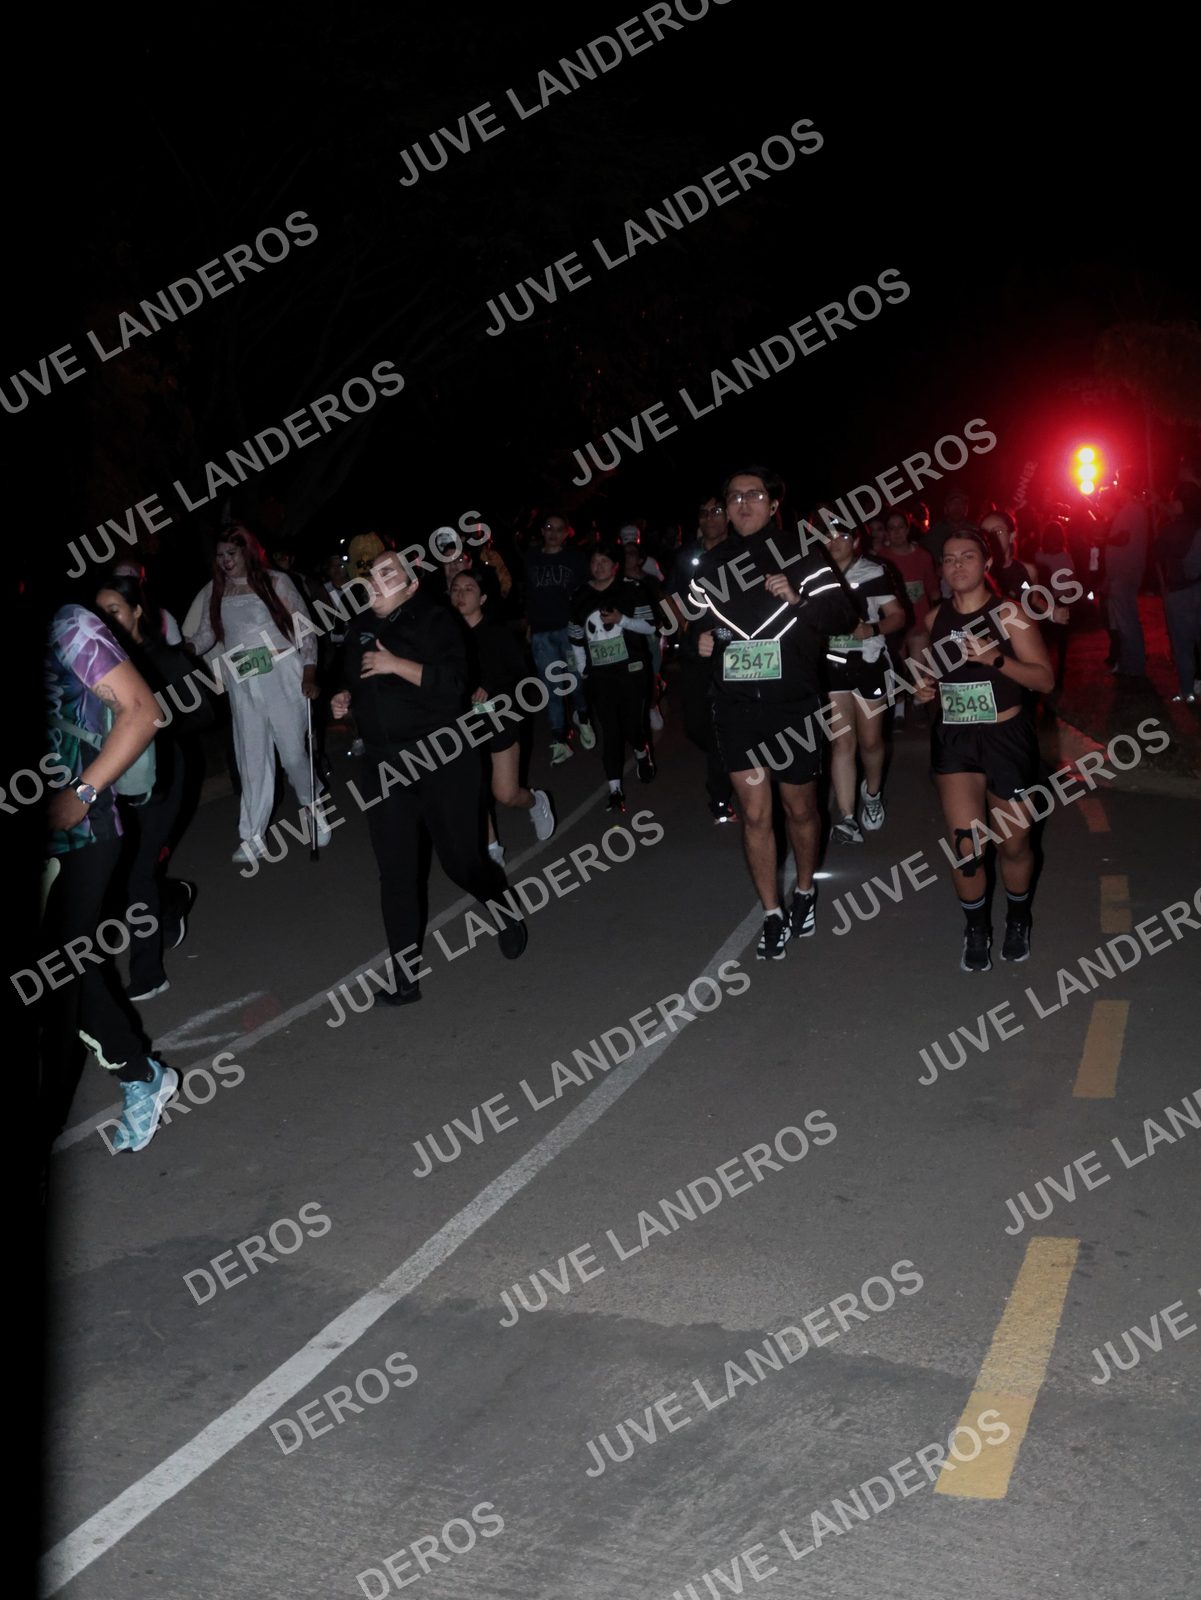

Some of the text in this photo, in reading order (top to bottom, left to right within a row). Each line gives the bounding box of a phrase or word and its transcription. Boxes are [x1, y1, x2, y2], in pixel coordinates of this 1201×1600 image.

[594, 643, 621, 660] 1827
[730, 652, 774, 670] 2547
[945, 694, 989, 714] 2548
